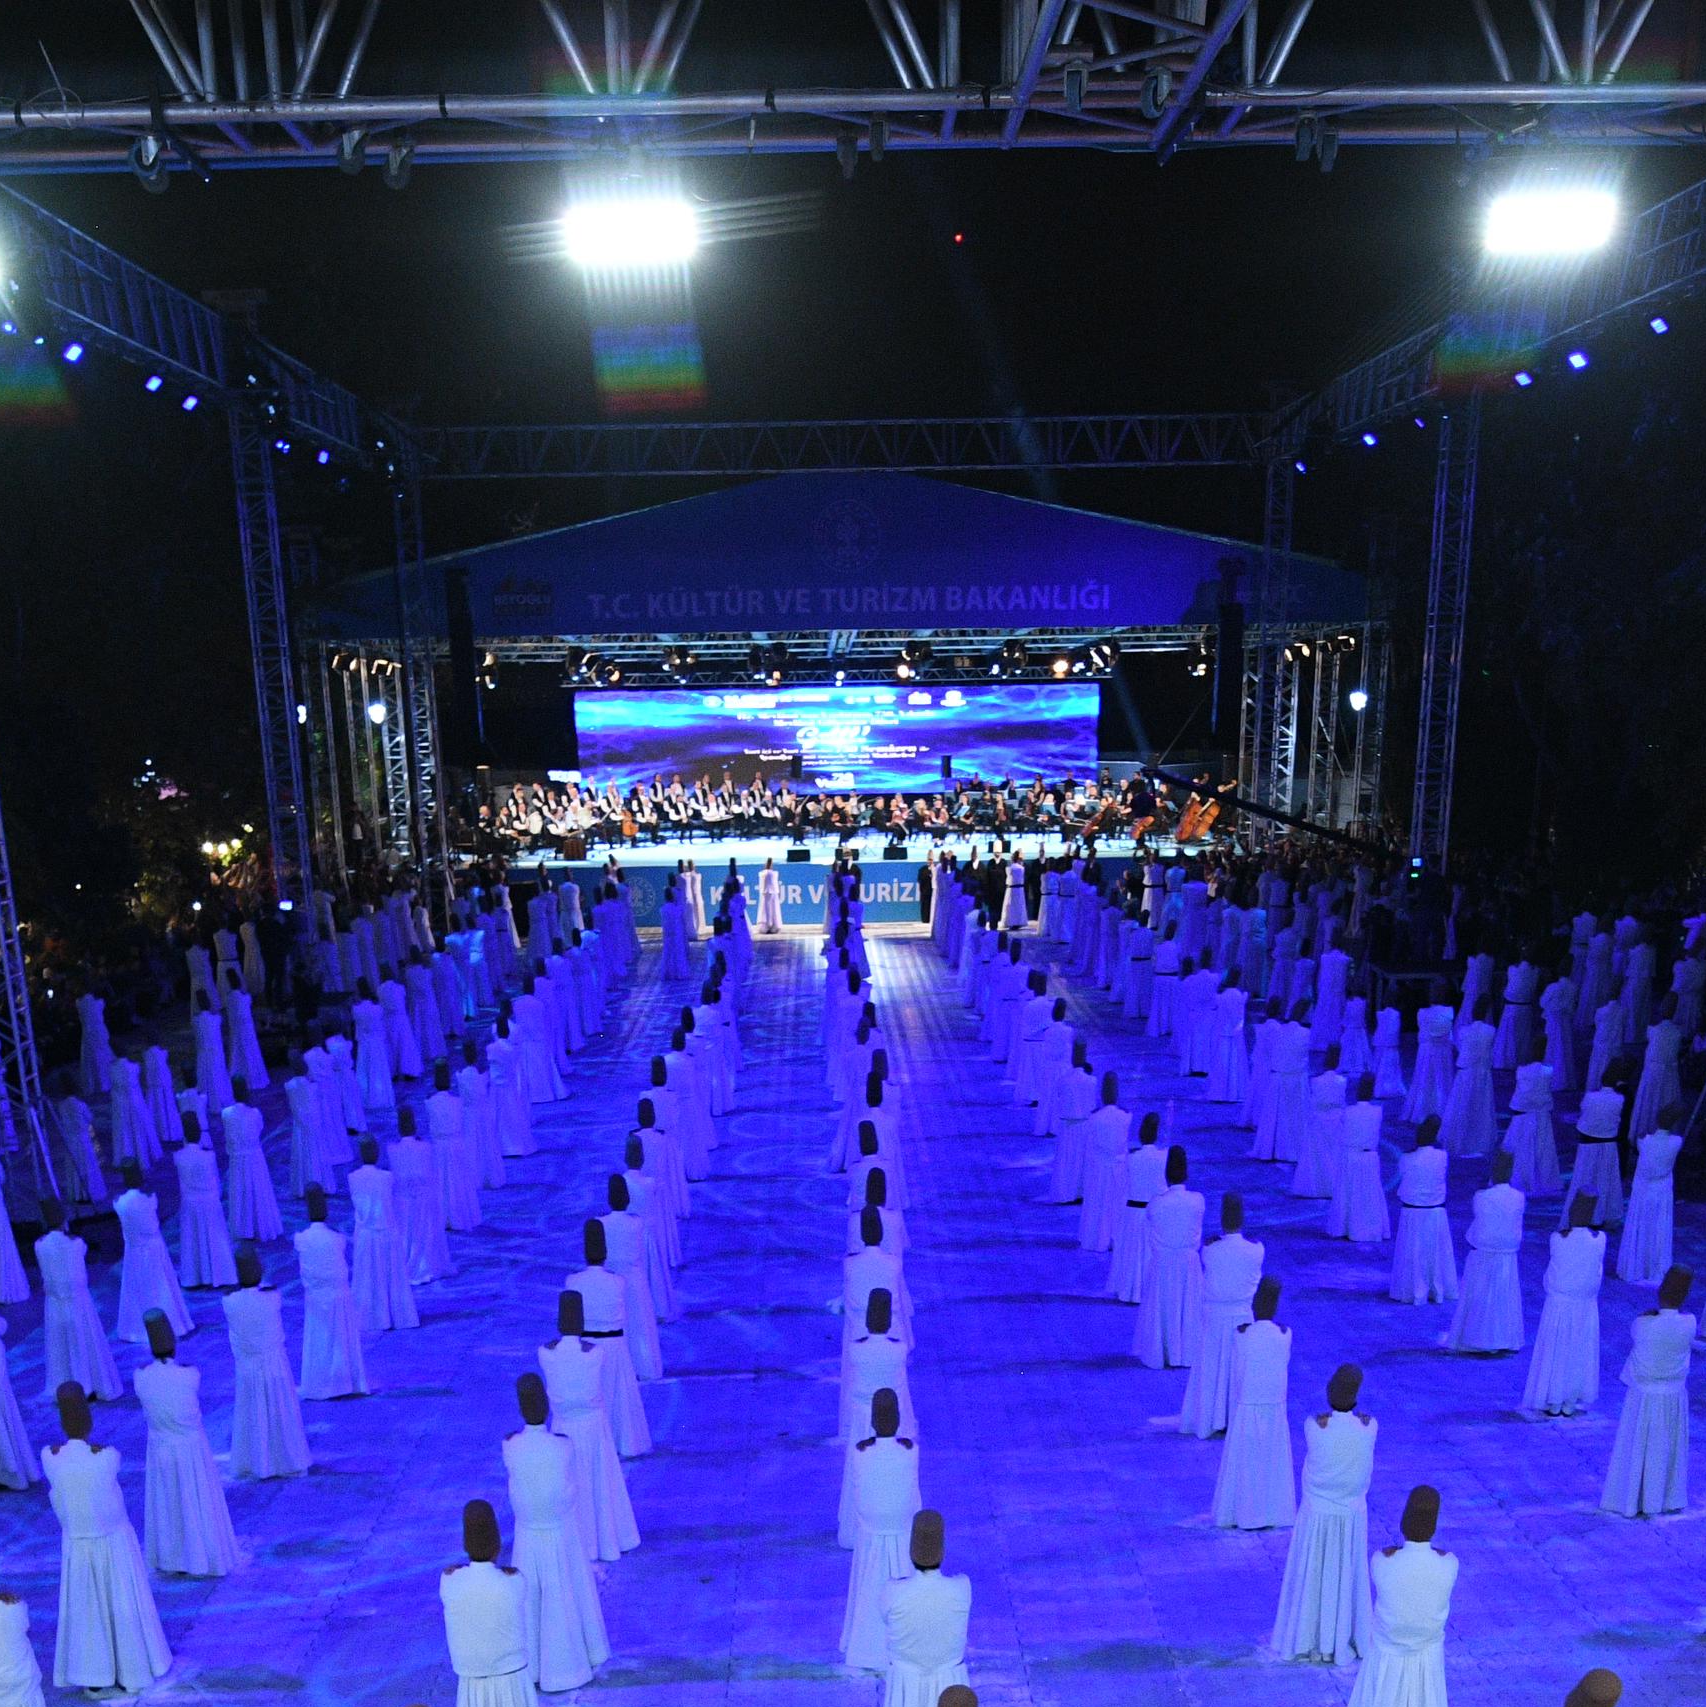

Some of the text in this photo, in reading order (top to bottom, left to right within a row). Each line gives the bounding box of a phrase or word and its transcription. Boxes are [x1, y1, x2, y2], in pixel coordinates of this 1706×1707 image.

[588, 577, 1111, 619] T.C. KÜLTÜR VE TURİZM BAKANLIĞI
[859, 877, 921, 903] URİZ
